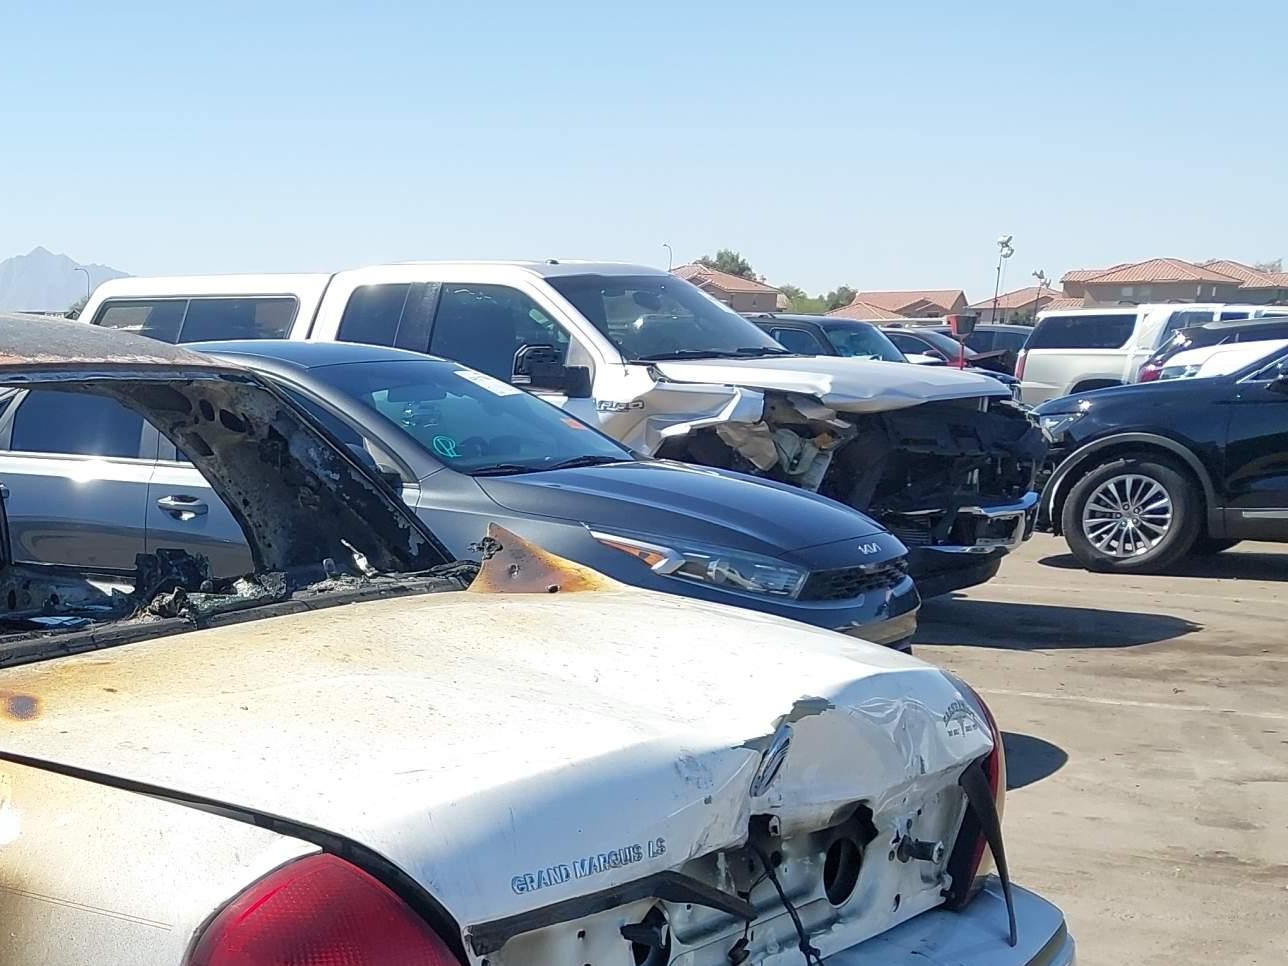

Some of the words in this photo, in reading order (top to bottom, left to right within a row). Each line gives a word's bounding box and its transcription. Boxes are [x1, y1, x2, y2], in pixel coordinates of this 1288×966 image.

[511, 864, 570, 894] GRAND
[573, 844, 643, 879] MARQUIS
[648, 837, 666, 858] LS
